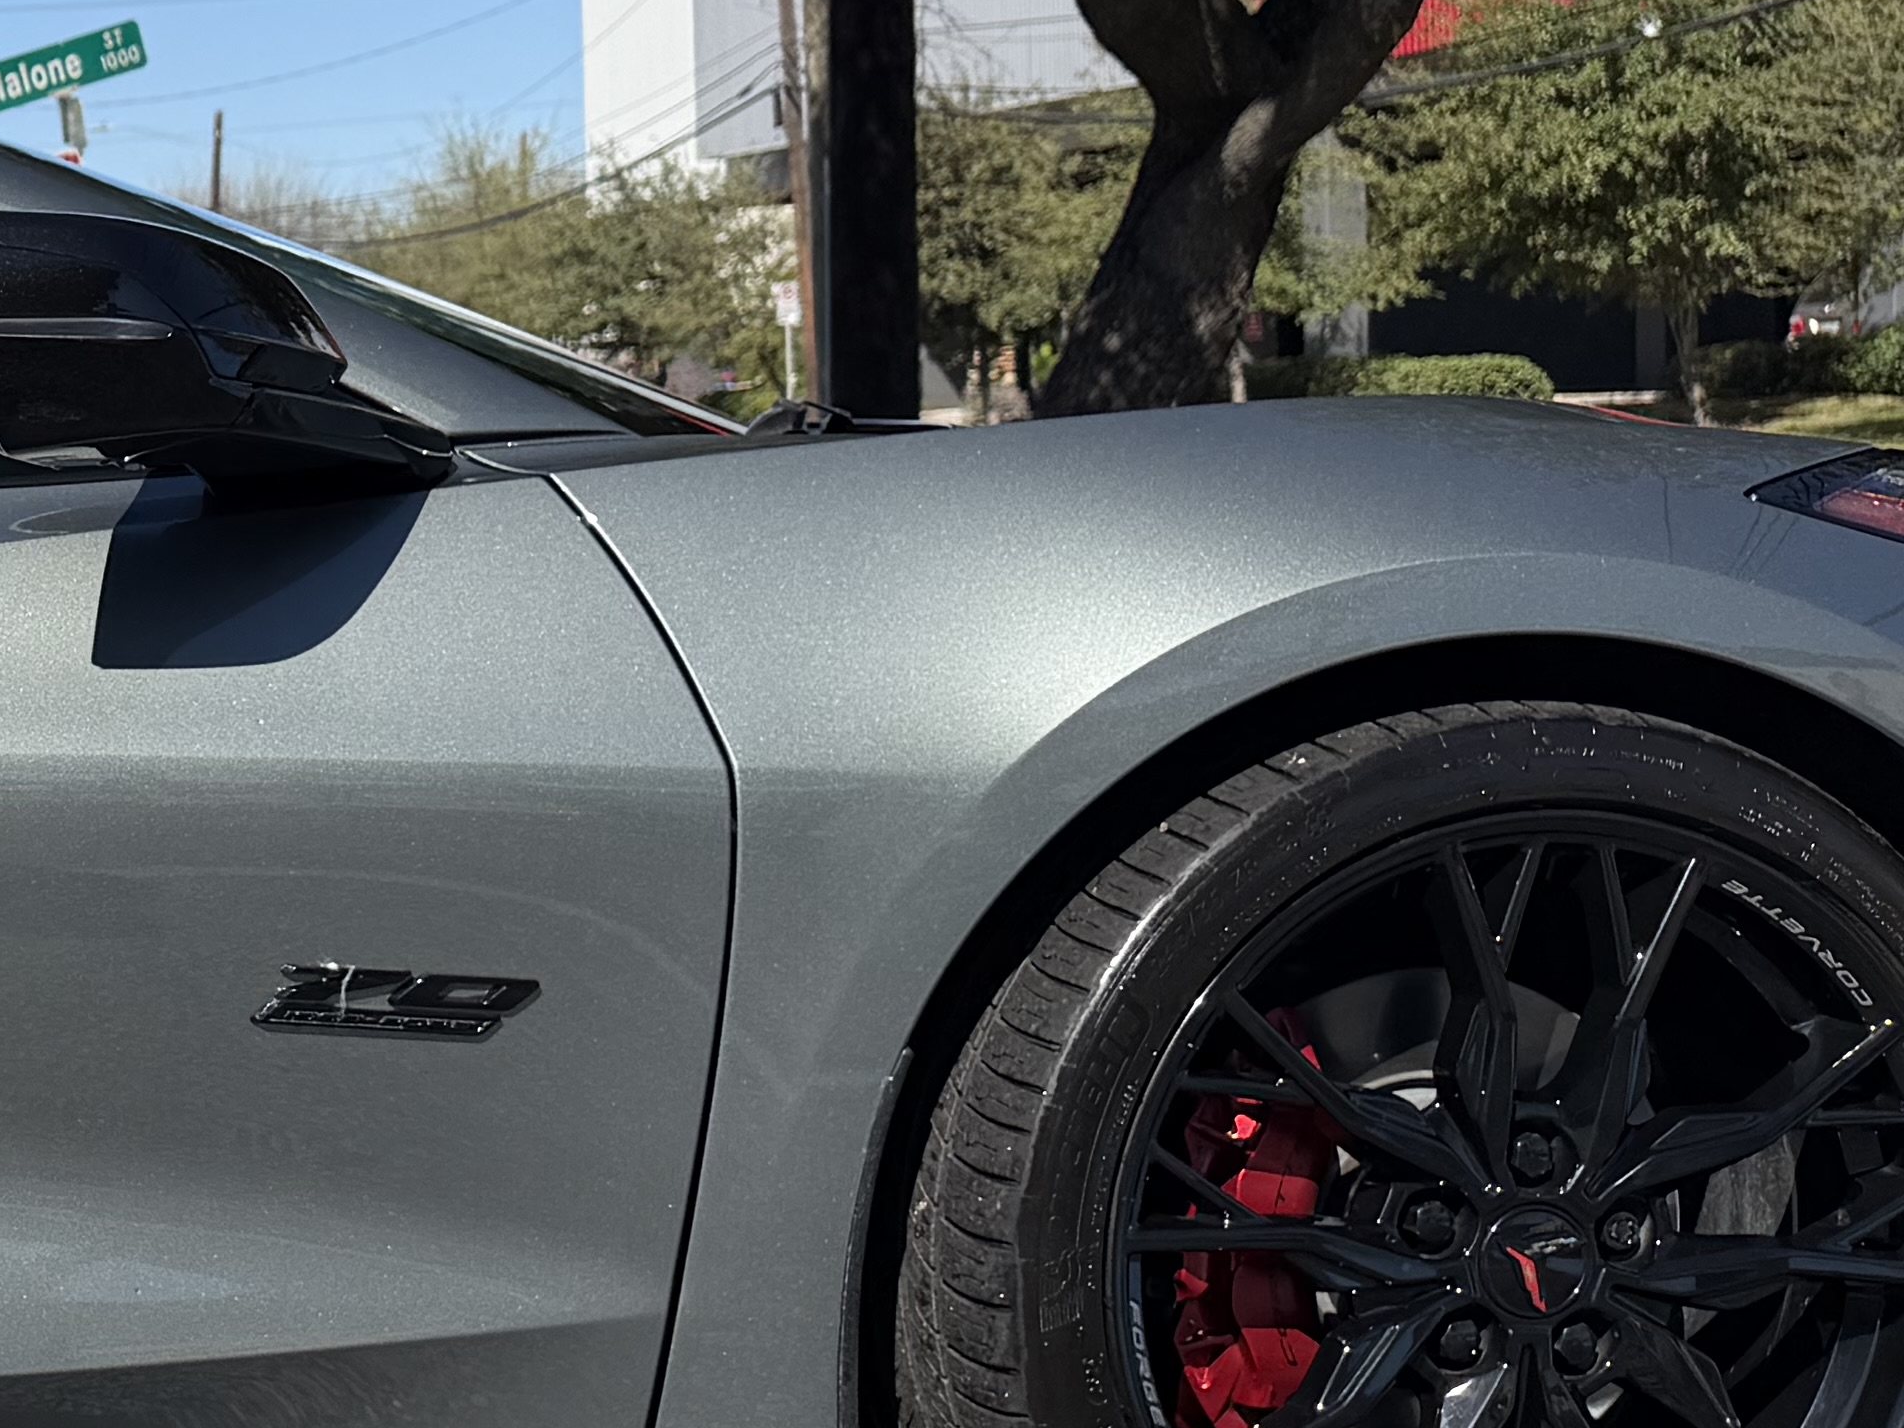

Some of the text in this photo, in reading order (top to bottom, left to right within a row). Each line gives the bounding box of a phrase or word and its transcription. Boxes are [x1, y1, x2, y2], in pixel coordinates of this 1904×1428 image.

[102, 27, 124, 50] ST
[100, 44, 141, 72] 1000
[1721, 879, 1874, 1007] CORVETTE
